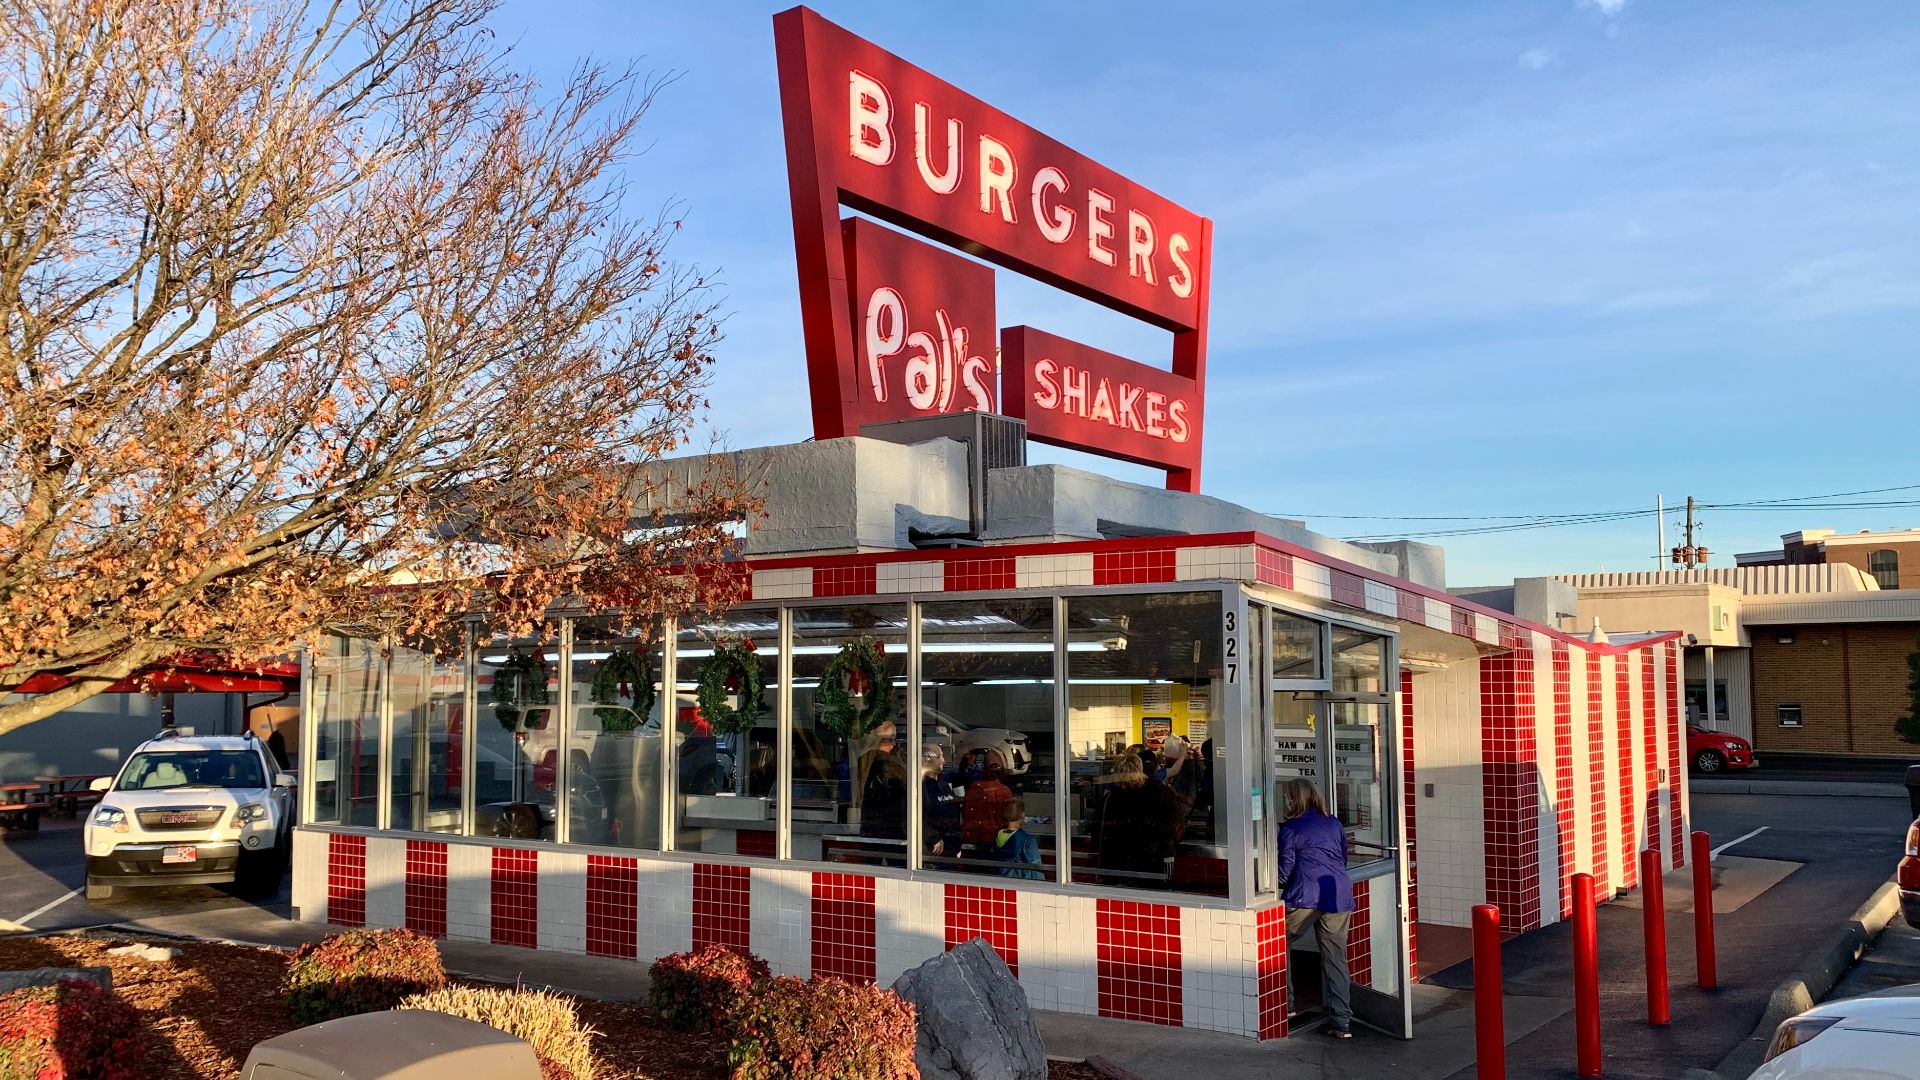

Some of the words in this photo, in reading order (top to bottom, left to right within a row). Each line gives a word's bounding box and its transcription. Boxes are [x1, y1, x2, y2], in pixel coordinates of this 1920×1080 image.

[849, 69, 1196, 300] BURGERS
[865, 286, 994, 412] Pal's
[1034, 359, 1192, 443] SHAKES
[1225, 611, 1237, 684] 327
[1282, 754, 1315, 763] FRENCH
[1335, 756, 1347, 764] RY
[1298, 768, 1316, 776] TEA
[1336, 769, 1351, 778] .97
[162, 815, 197, 824] GMC
